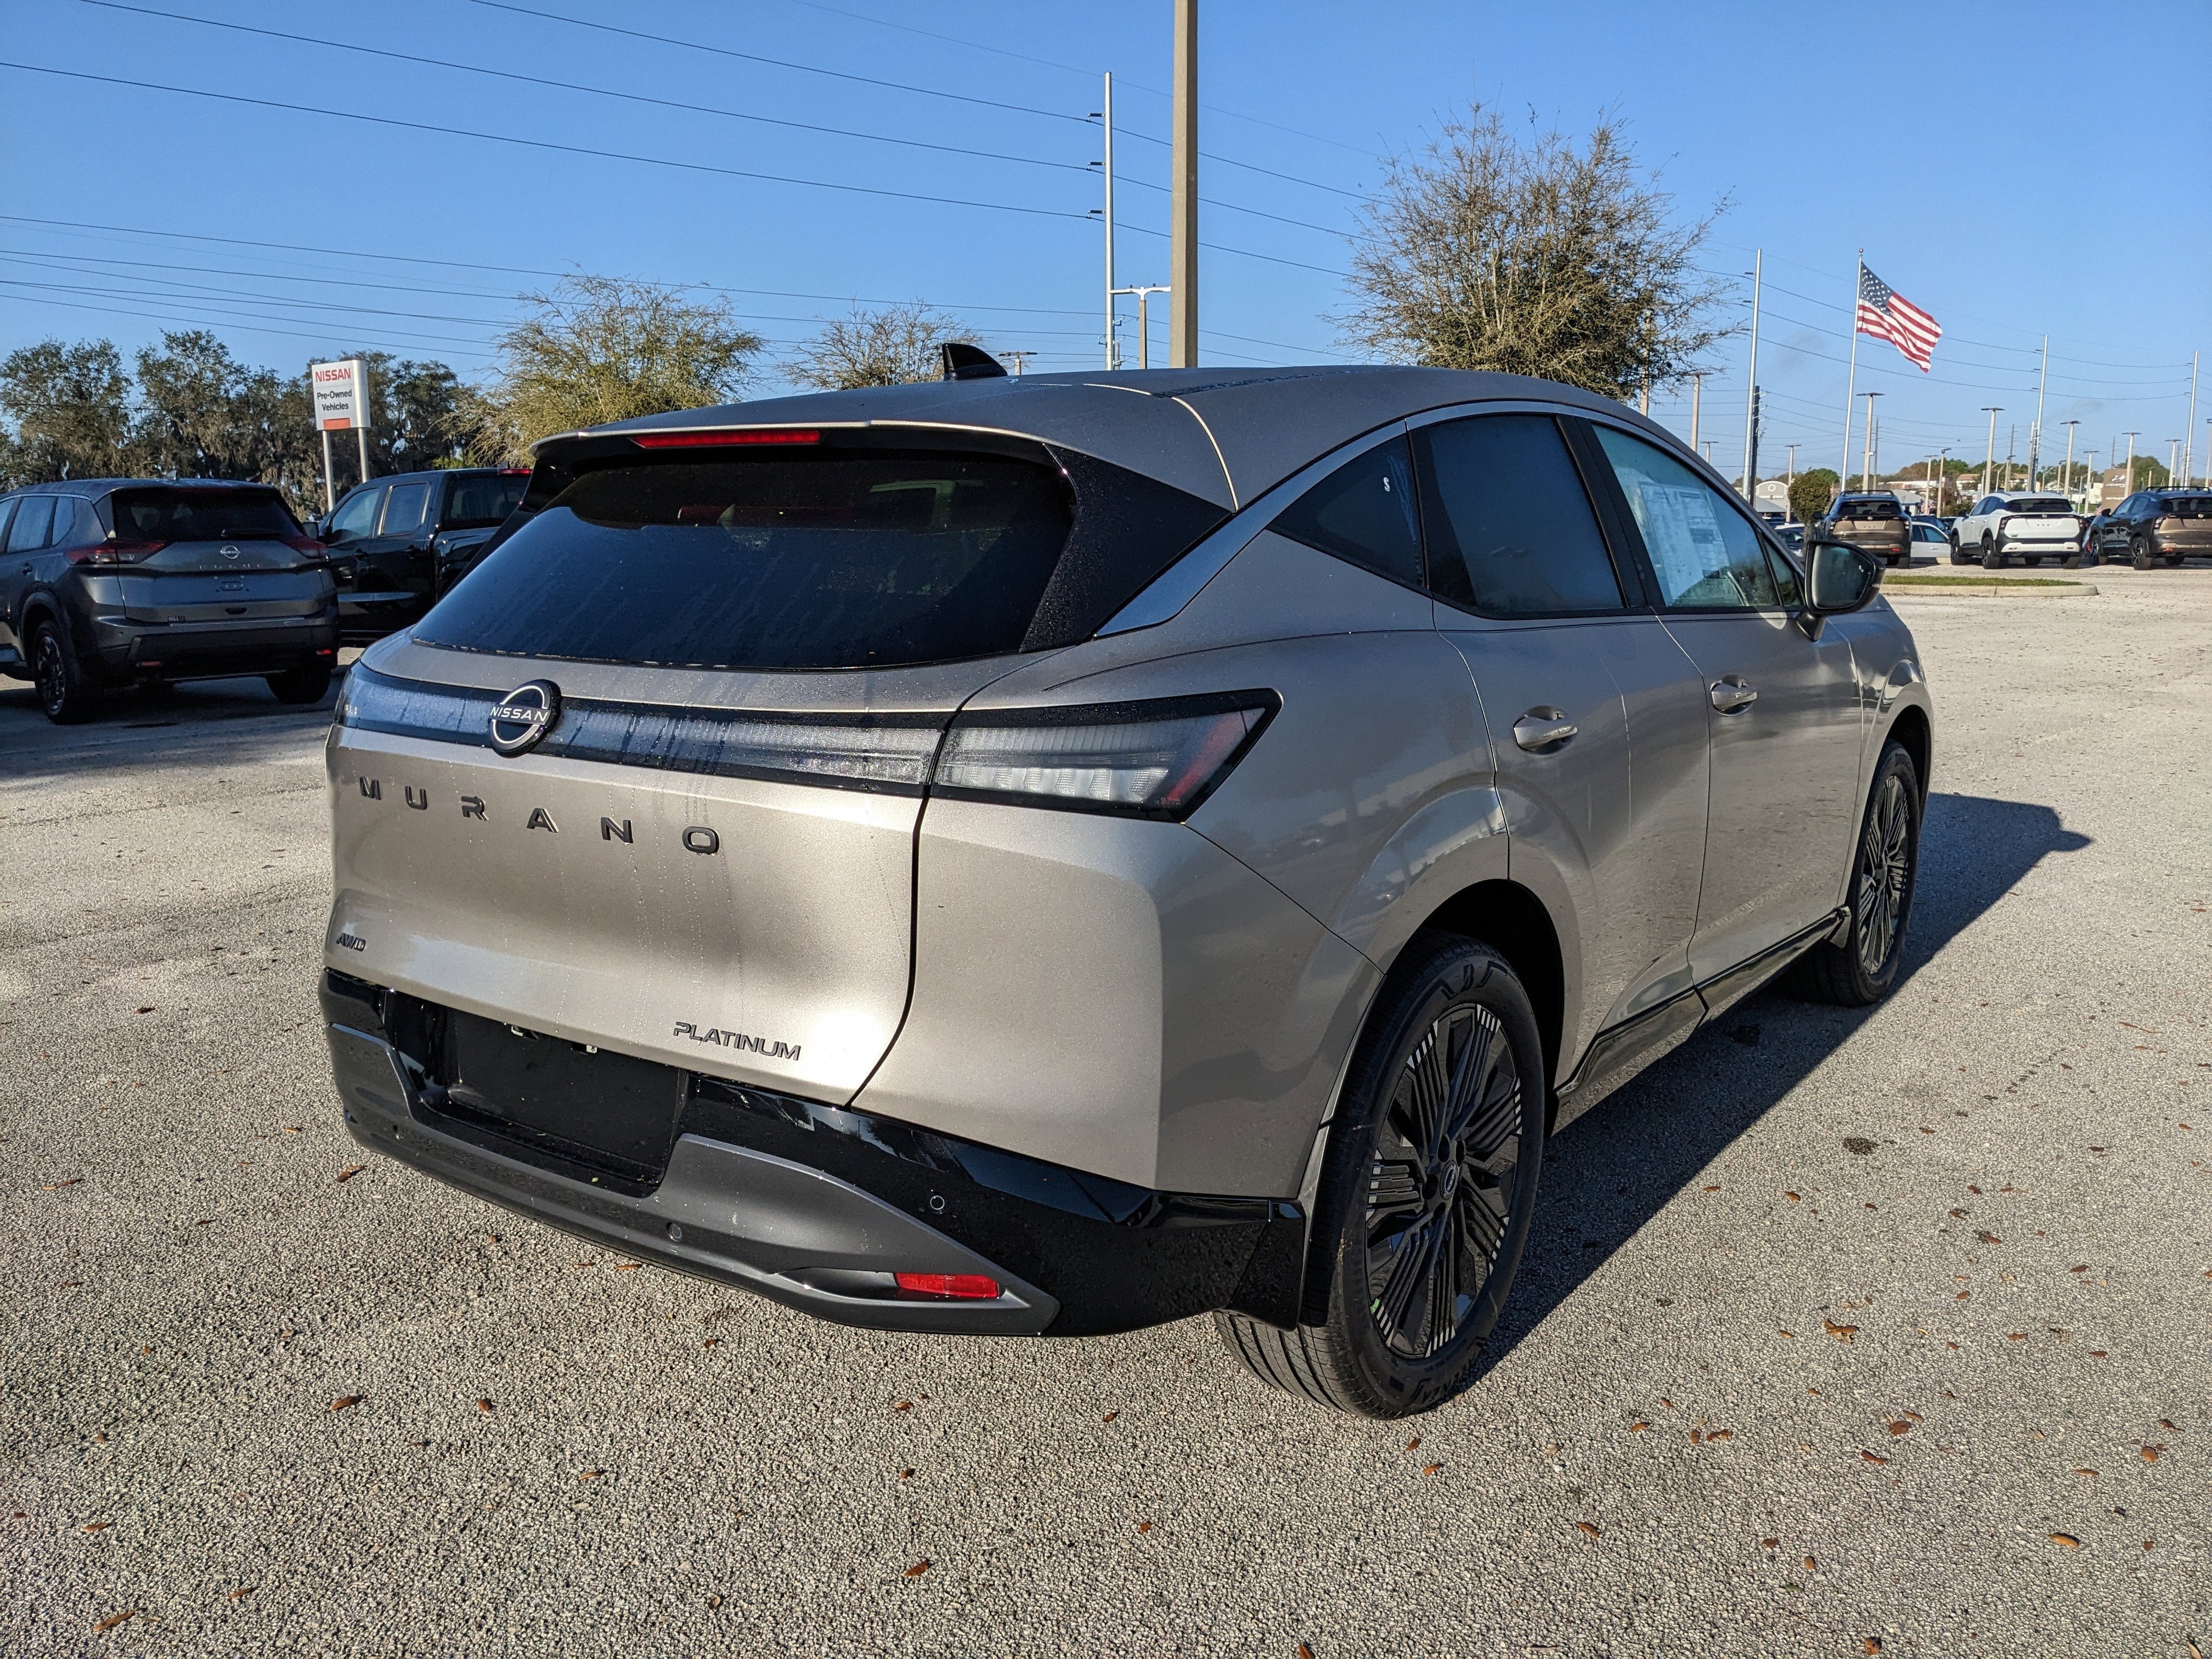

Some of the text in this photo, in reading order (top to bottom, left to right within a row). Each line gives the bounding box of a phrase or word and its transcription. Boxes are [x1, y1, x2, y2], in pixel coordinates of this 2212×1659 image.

[315, 368, 351, 382] NISSAN
[317, 389, 352, 400] Pre-Owned
[322, 402, 349, 411] Vehicles
[489, 706, 549, 722] NISSAN
[359, 776, 719, 855] MURANO
[335, 932, 366, 952] AWD
[673, 1021, 802, 1061] PLATINUM
